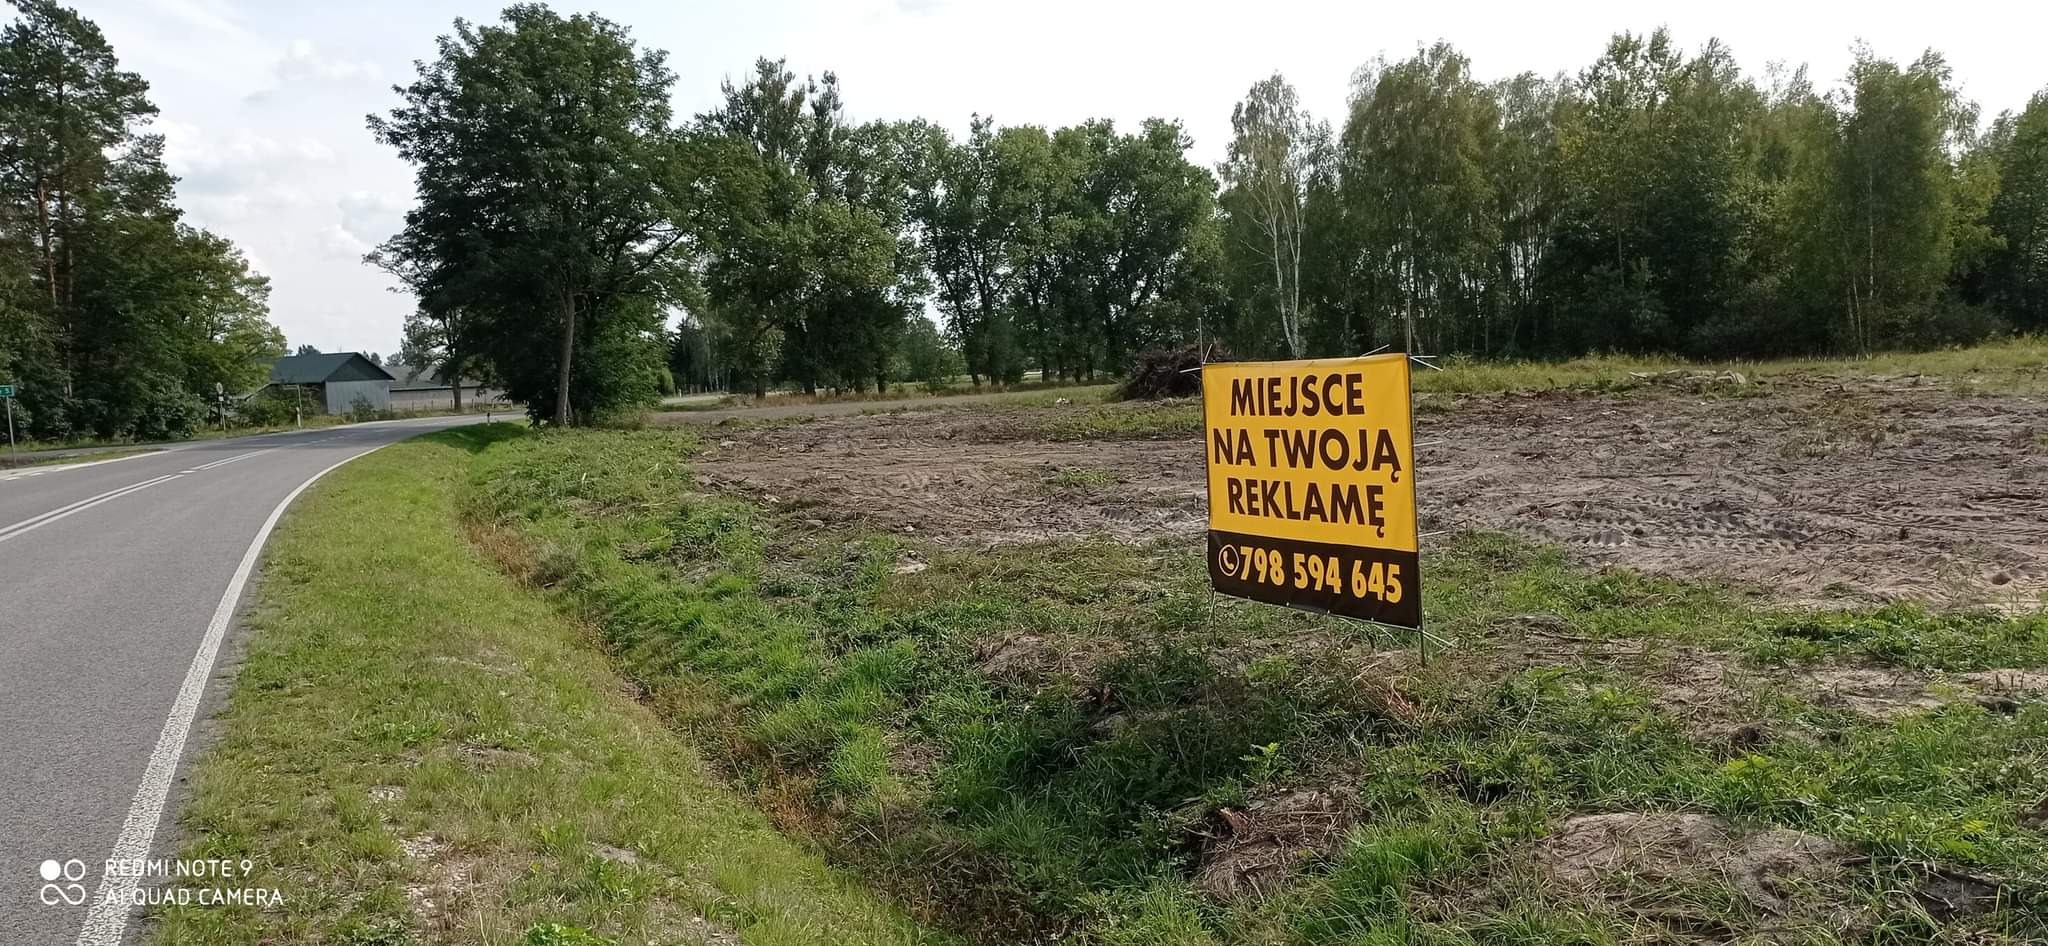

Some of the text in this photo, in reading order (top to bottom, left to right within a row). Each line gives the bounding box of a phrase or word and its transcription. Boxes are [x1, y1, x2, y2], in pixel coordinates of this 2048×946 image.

[1230, 373, 1365, 417] MIEJSCE
[1213, 428, 1402, 483] NA TWOJĄ
[1227, 477, 1385, 538] REKLAMĘ
[1239, 546, 1402, 604] 798 594 645
